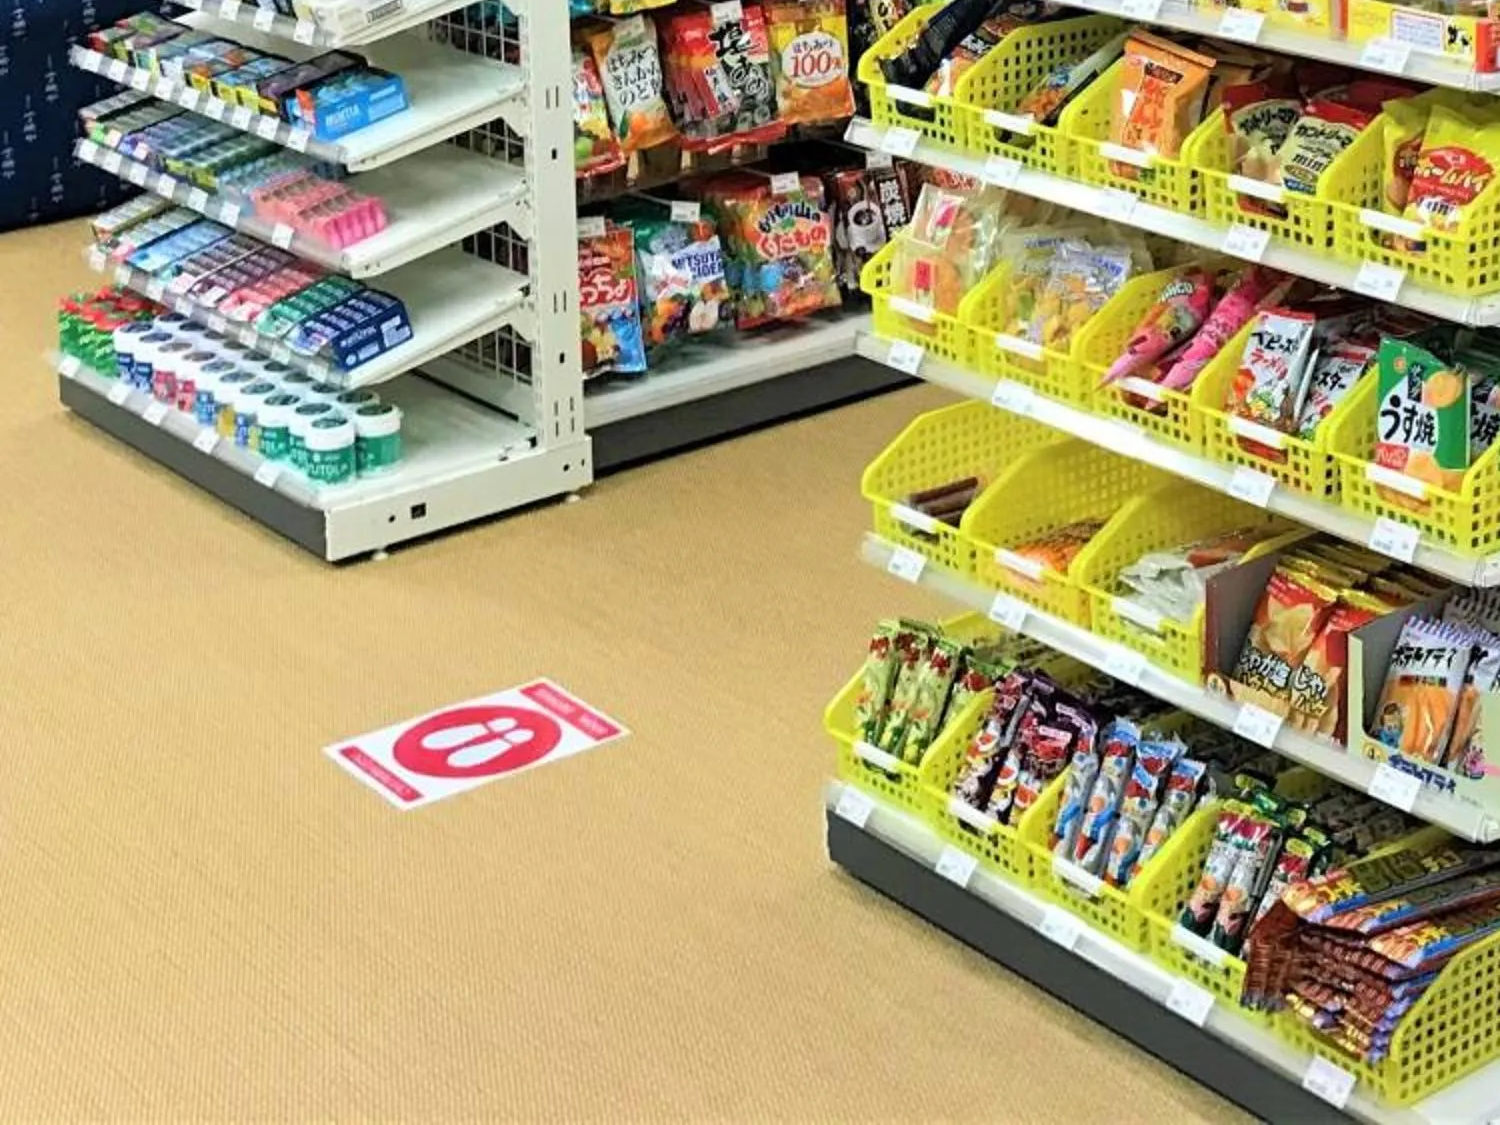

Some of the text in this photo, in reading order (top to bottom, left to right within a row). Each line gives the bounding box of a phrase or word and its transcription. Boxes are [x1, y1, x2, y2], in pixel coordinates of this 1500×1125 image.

[759, 225, 828, 258] くだもの
[1379, 393, 1437, 446] うす焼
[1391, 643, 1458, 669] ポテトフライ
